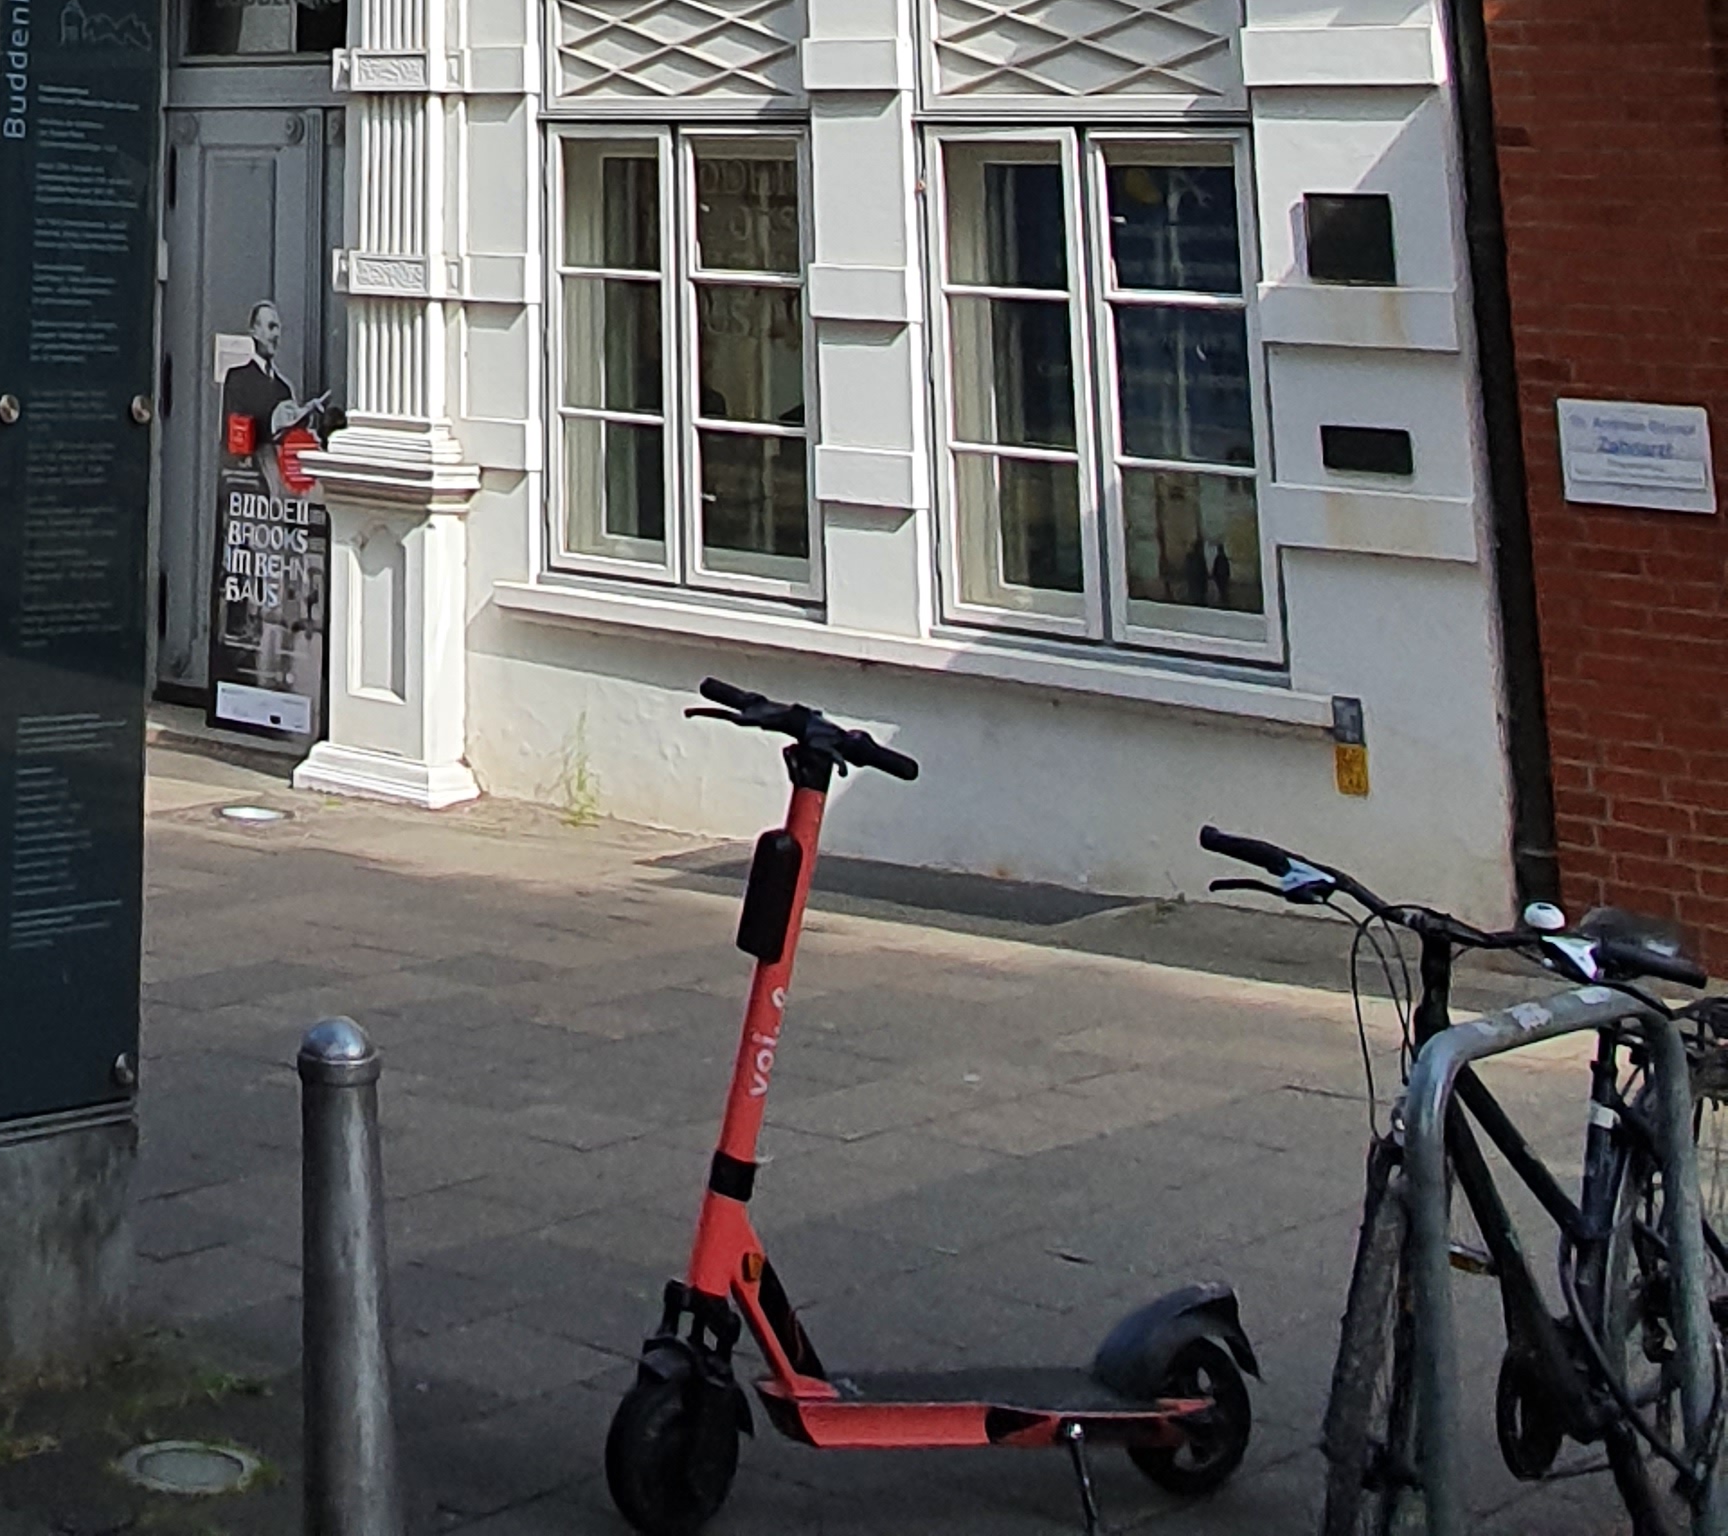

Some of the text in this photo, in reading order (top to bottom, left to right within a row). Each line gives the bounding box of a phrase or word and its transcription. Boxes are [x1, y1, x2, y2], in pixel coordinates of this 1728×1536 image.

[227, 520, 309, 554] BROOKS
[223, 544, 308, 584] IM BEHN
[225, 575, 280, 608] HAUS
